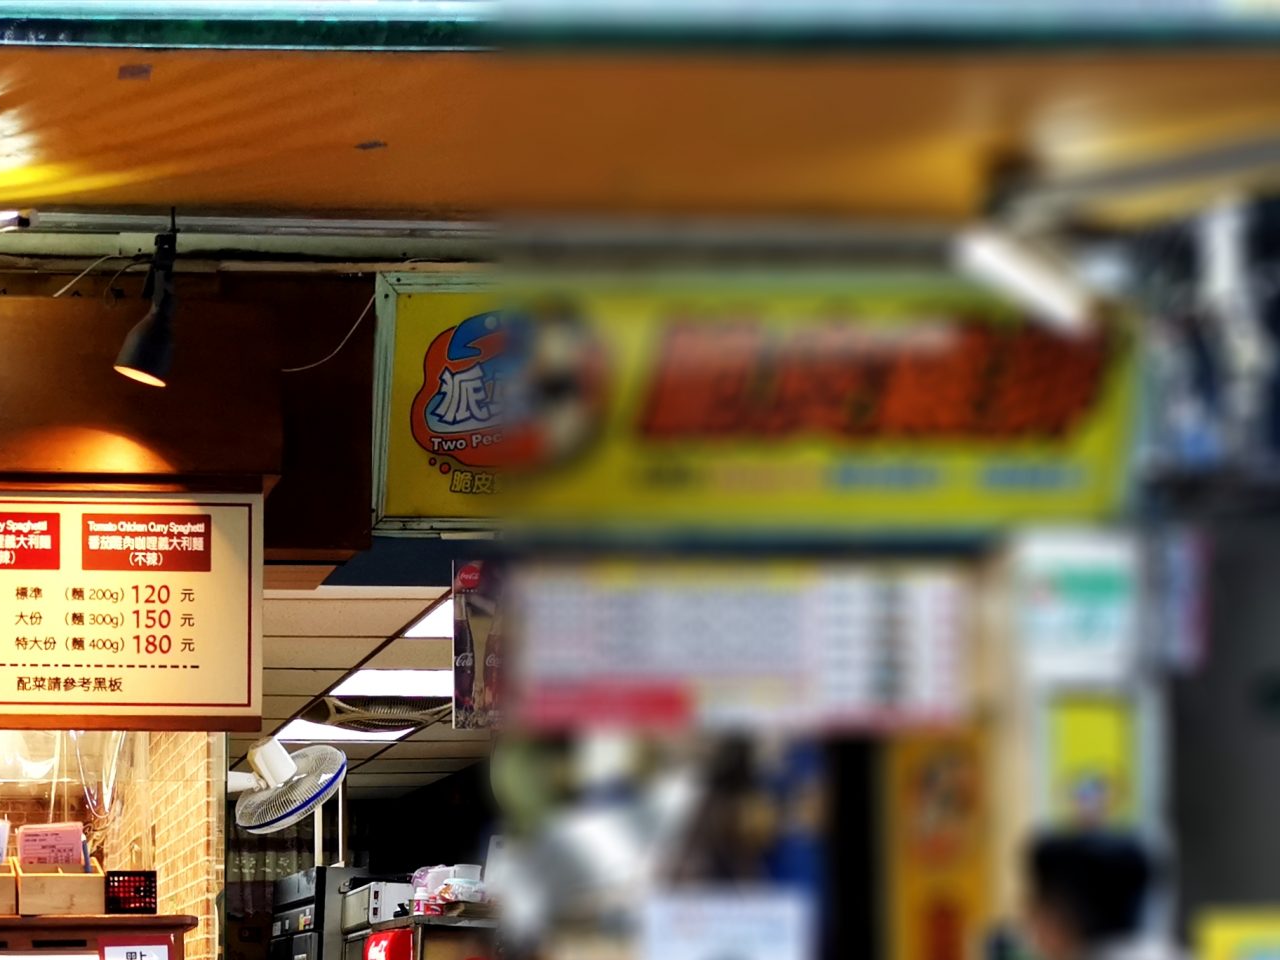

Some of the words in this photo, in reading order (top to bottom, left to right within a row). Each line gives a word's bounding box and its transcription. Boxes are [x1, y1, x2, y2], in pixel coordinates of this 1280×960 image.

[431, 437, 466, 451] Two
[472, 431, 512, 448] Pec
[131, 584, 171, 604] 120
[180, 589, 195, 602] 元
[15, 612, 42, 626] 大份
[131, 609, 171, 629] 150
[180, 614, 195, 627] 元
[15, 637, 56, 651] 特大份
[132, 634, 172, 654] 180
[180, 639, 195, 652] 元
[16, 676, 123, 692] 配菜請參考黑板
